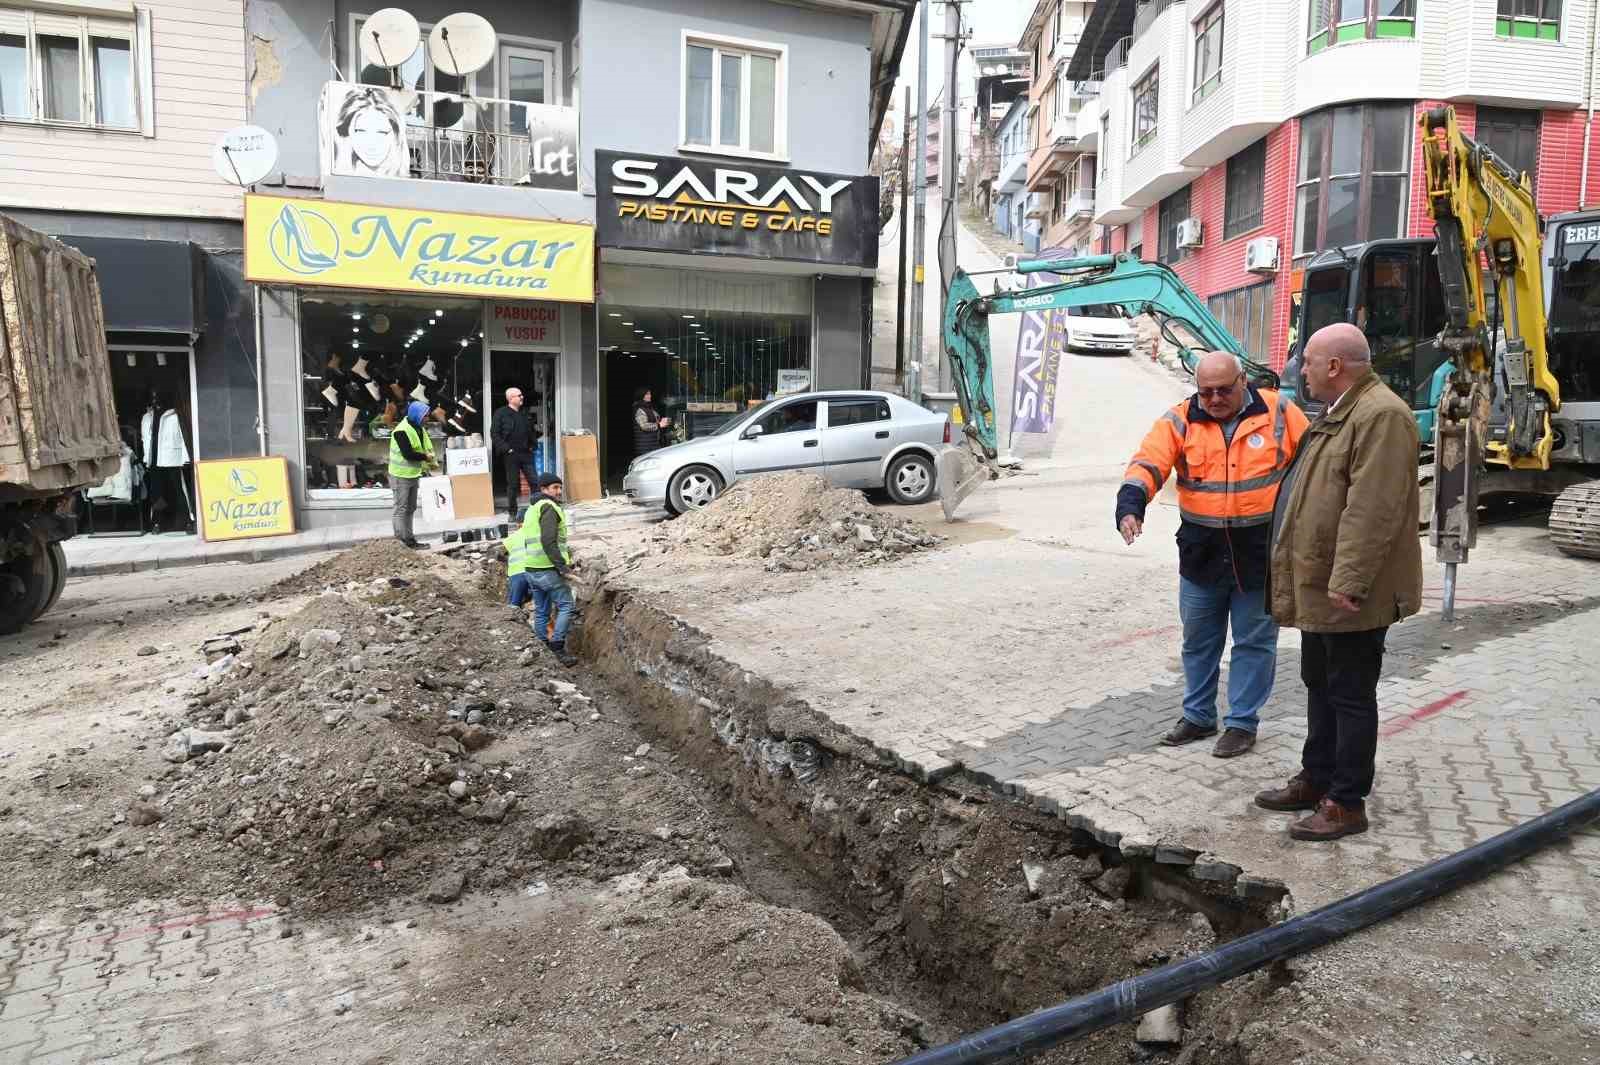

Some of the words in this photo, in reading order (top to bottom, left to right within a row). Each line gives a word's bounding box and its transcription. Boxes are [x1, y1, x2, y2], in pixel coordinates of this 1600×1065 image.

[611, 159, 853, 213] SARAY
[618, 202, 736, 227] PASTANE
[741, 214, 760, 231] &
[766, 215, 832, 236] CAFE
[343, 214, 576, 270] Nazar
[408, 262, 549, 290] kundura
[505, 326, 547, 341] YUSUF
[209, 498, 283, 522] Nazar
